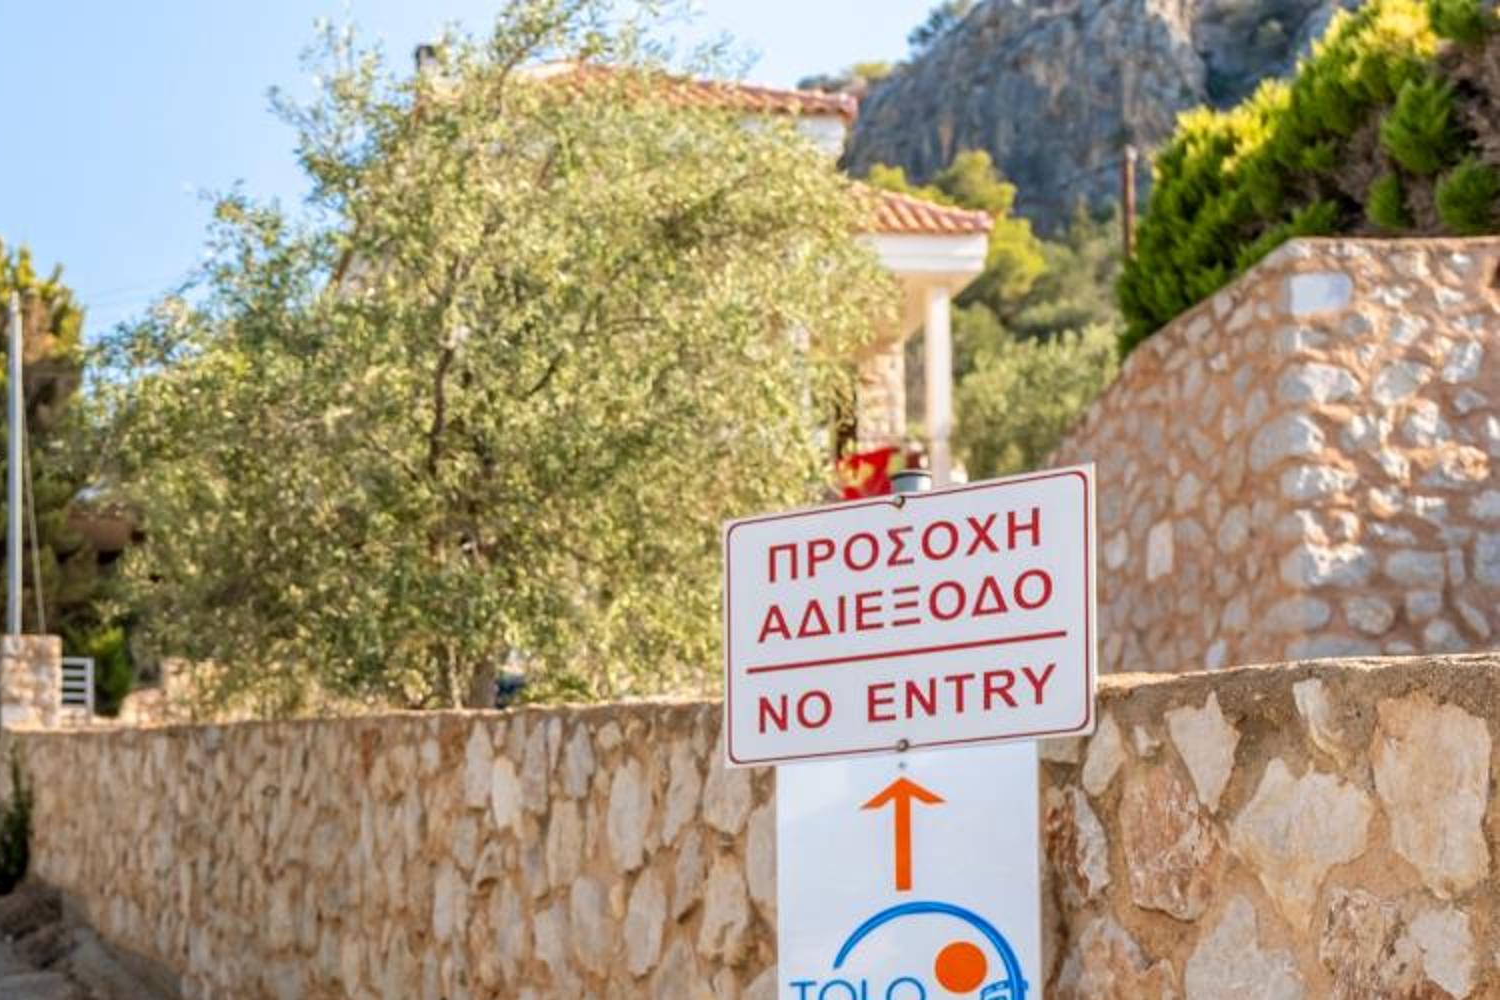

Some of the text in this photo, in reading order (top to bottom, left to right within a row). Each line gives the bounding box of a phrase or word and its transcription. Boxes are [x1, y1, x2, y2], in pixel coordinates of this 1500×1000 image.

[767, 507, 1041, 583] ΠΡΟΣΟΧΗ
[757, 569, 1054, 643] ΑΔΙΕΞΟΔΟ
[758, 663, 1056, 734] NO ENTRY
